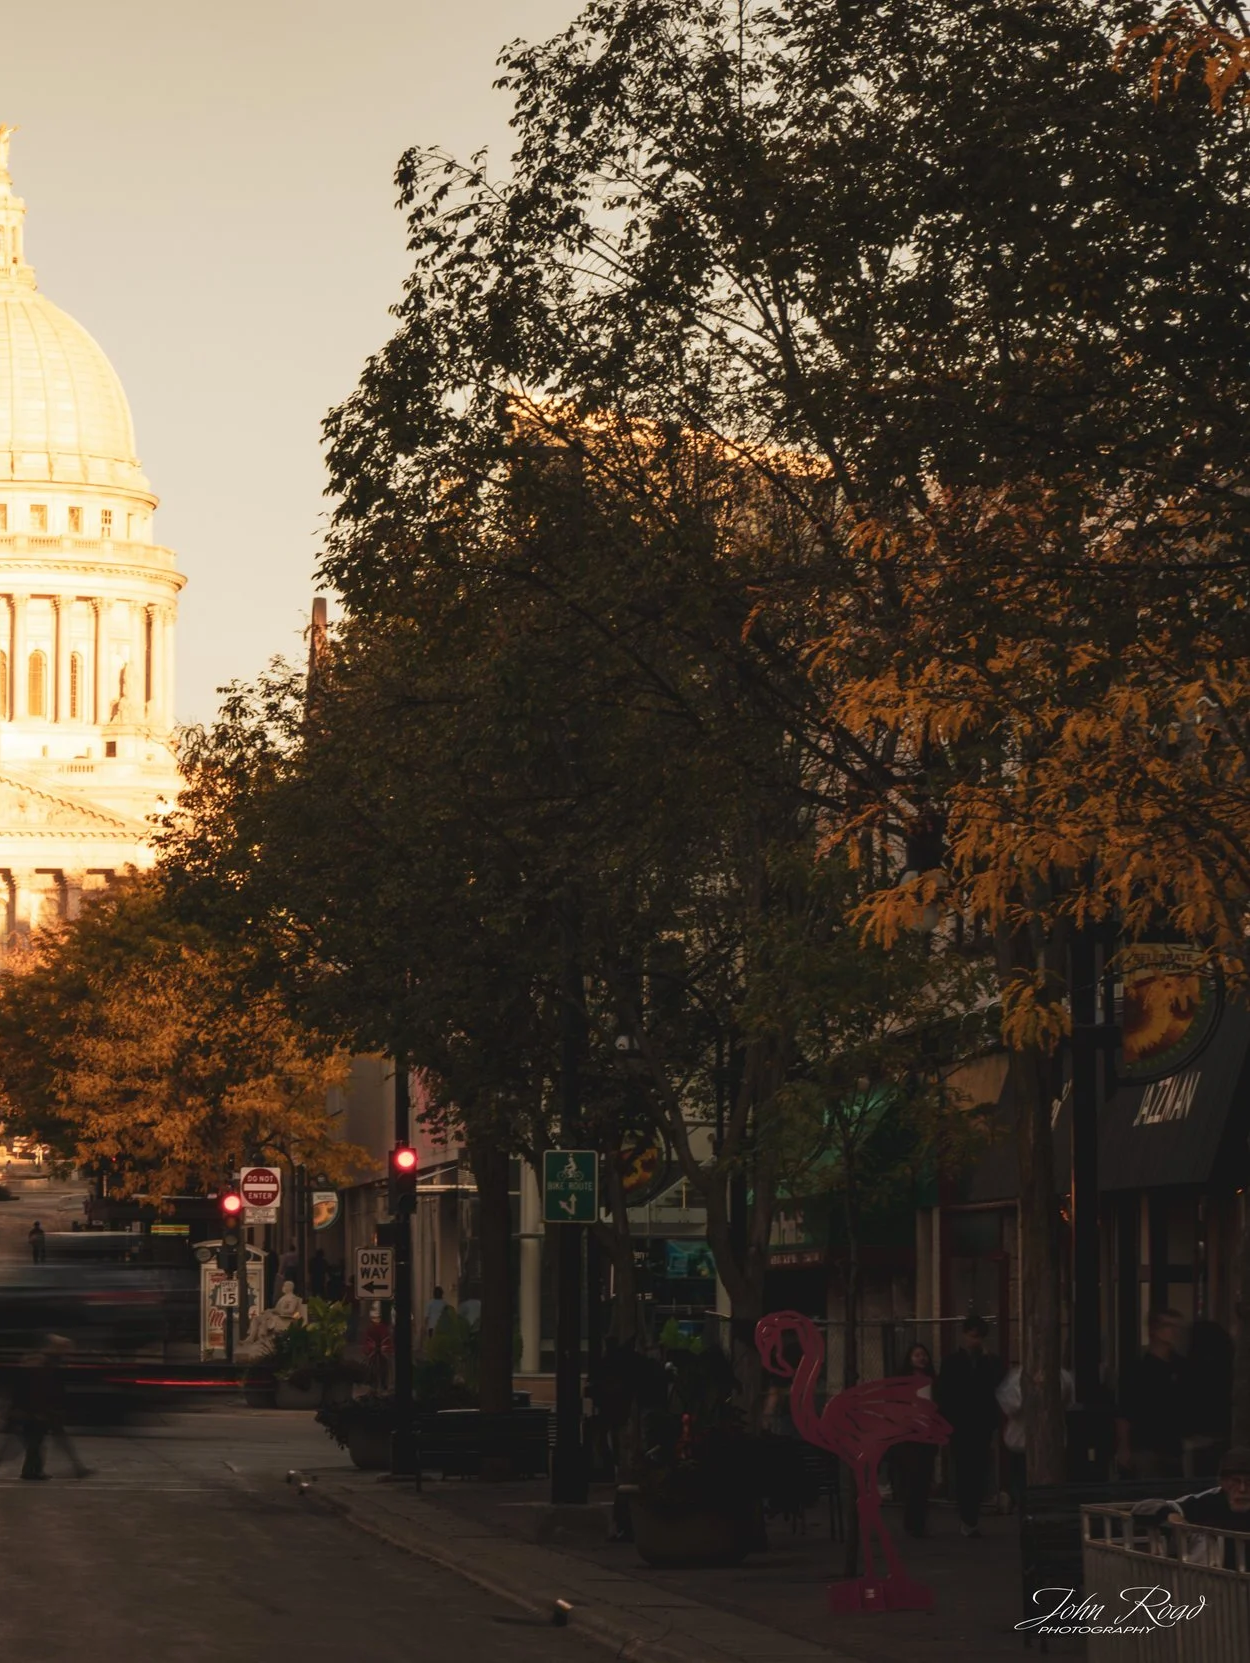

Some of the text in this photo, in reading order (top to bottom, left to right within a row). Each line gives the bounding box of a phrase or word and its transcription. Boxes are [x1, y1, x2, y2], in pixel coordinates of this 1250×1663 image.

[546, 1181, 593, 1191] BIKE ROUTE
[248, 1192, 273, 1200] ENTER
[361, 1253, 389, 1265] ONE
[360, 1267, 389, 1279] WAY
[223, 1293, 236, 1305] 15
